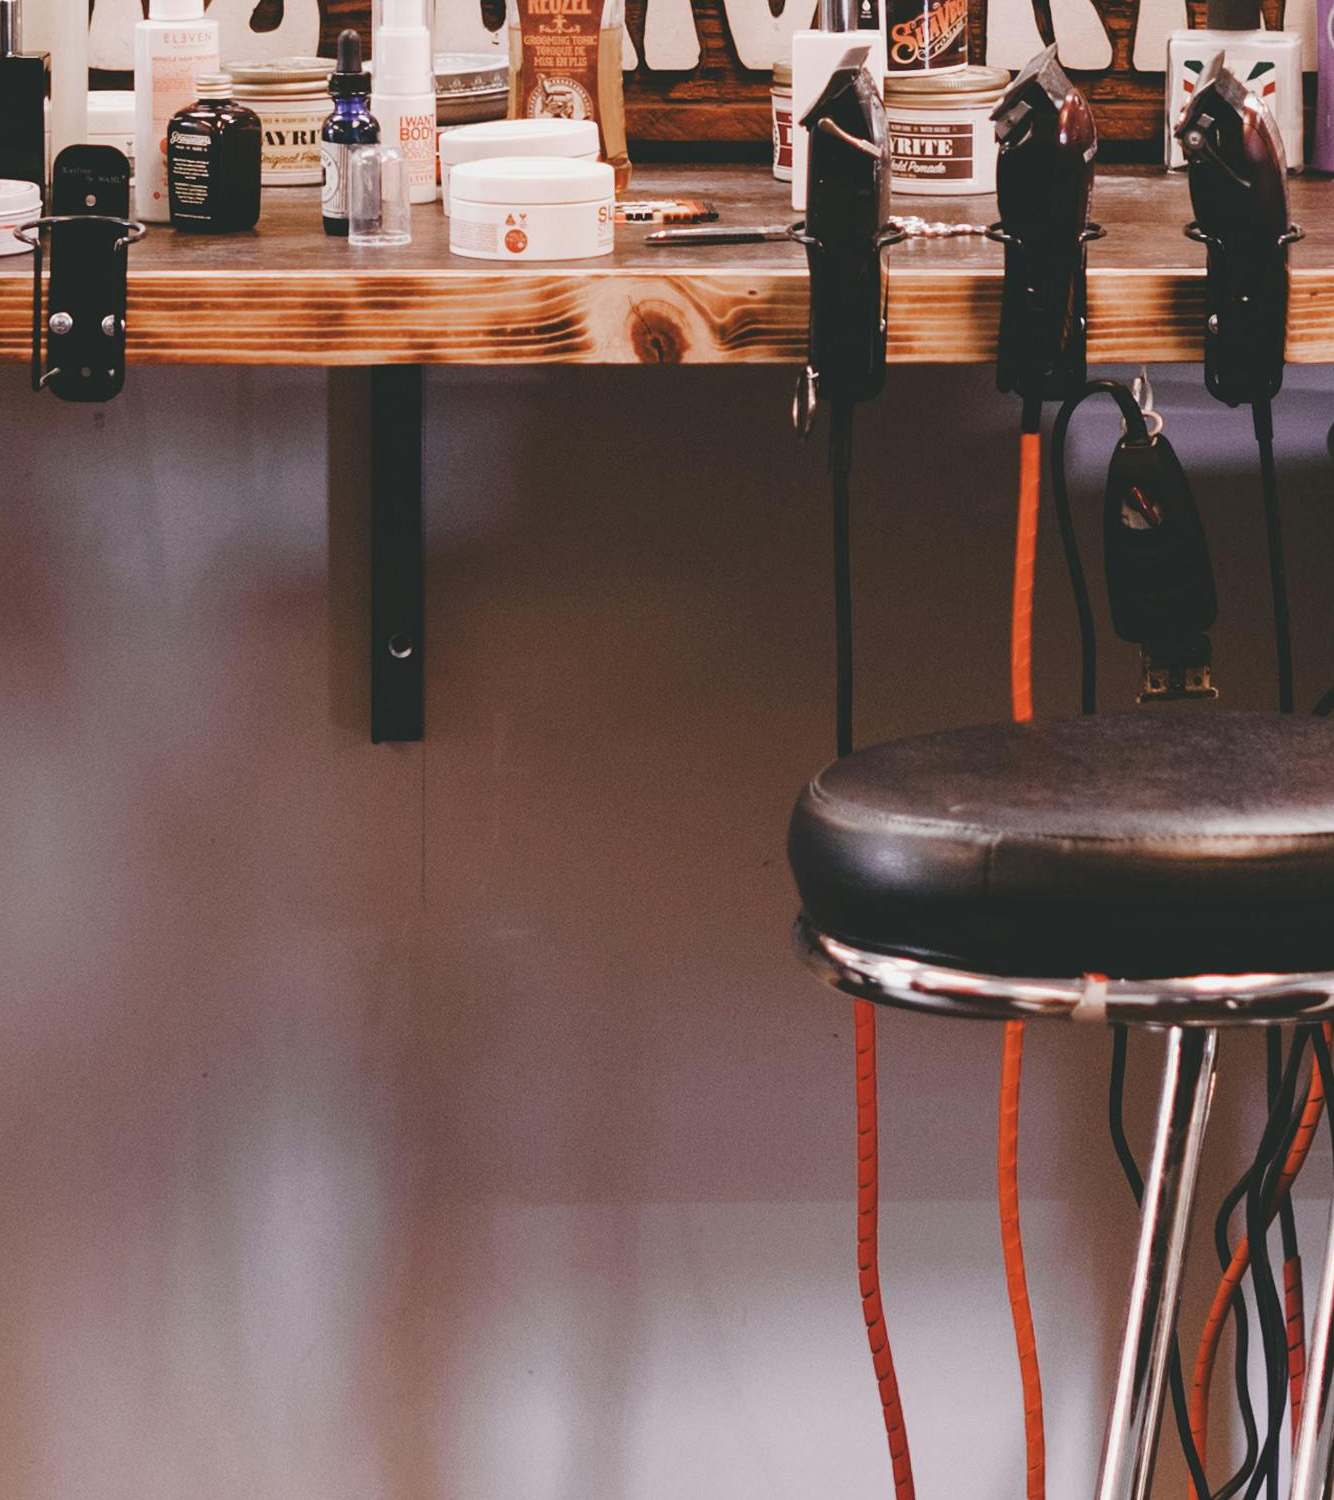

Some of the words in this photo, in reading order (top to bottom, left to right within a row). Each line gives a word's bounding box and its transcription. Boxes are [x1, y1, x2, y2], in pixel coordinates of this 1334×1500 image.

[523, 35, 570, 46] GROOMING
[572, 35, 598, 45] TONIC
[533, 57, 555, 66] MISE
[399, 126, 435, 141] BODY
